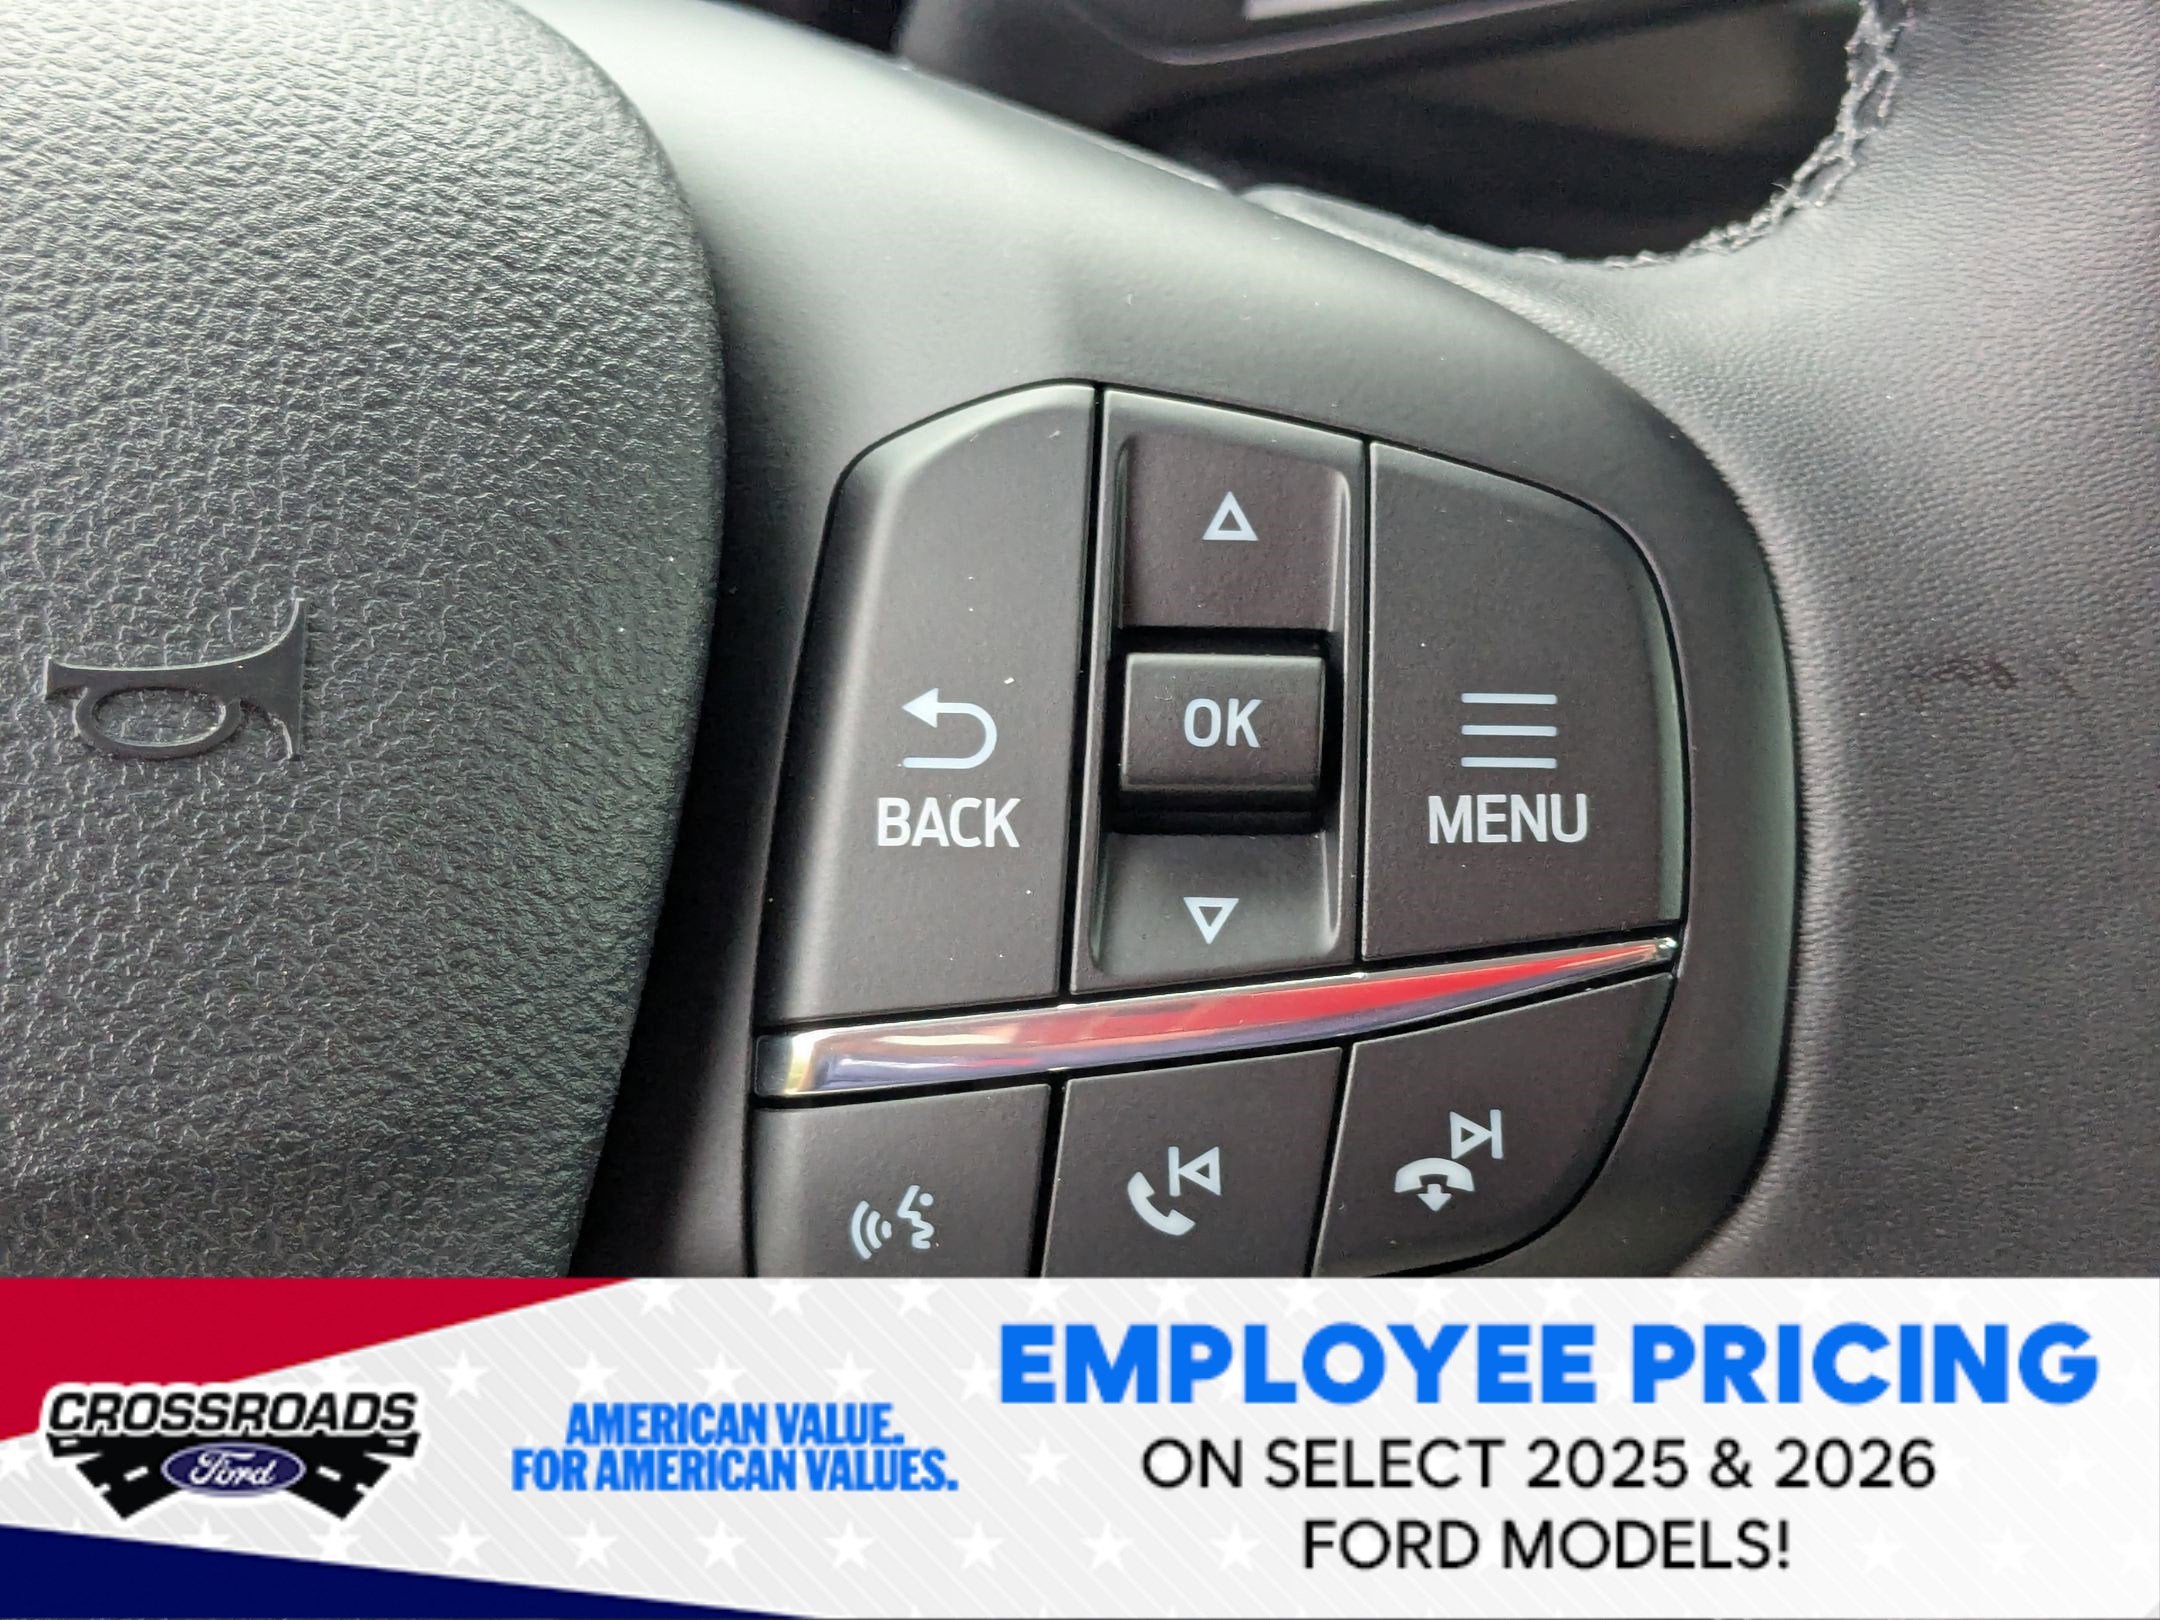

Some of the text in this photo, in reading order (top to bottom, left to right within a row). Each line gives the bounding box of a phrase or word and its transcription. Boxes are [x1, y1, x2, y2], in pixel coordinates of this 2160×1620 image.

[1183, 697, 1262, 748] OK
[877, 797, 1020, 848] BACK
[1428, 793, 1588, 844] MENU
